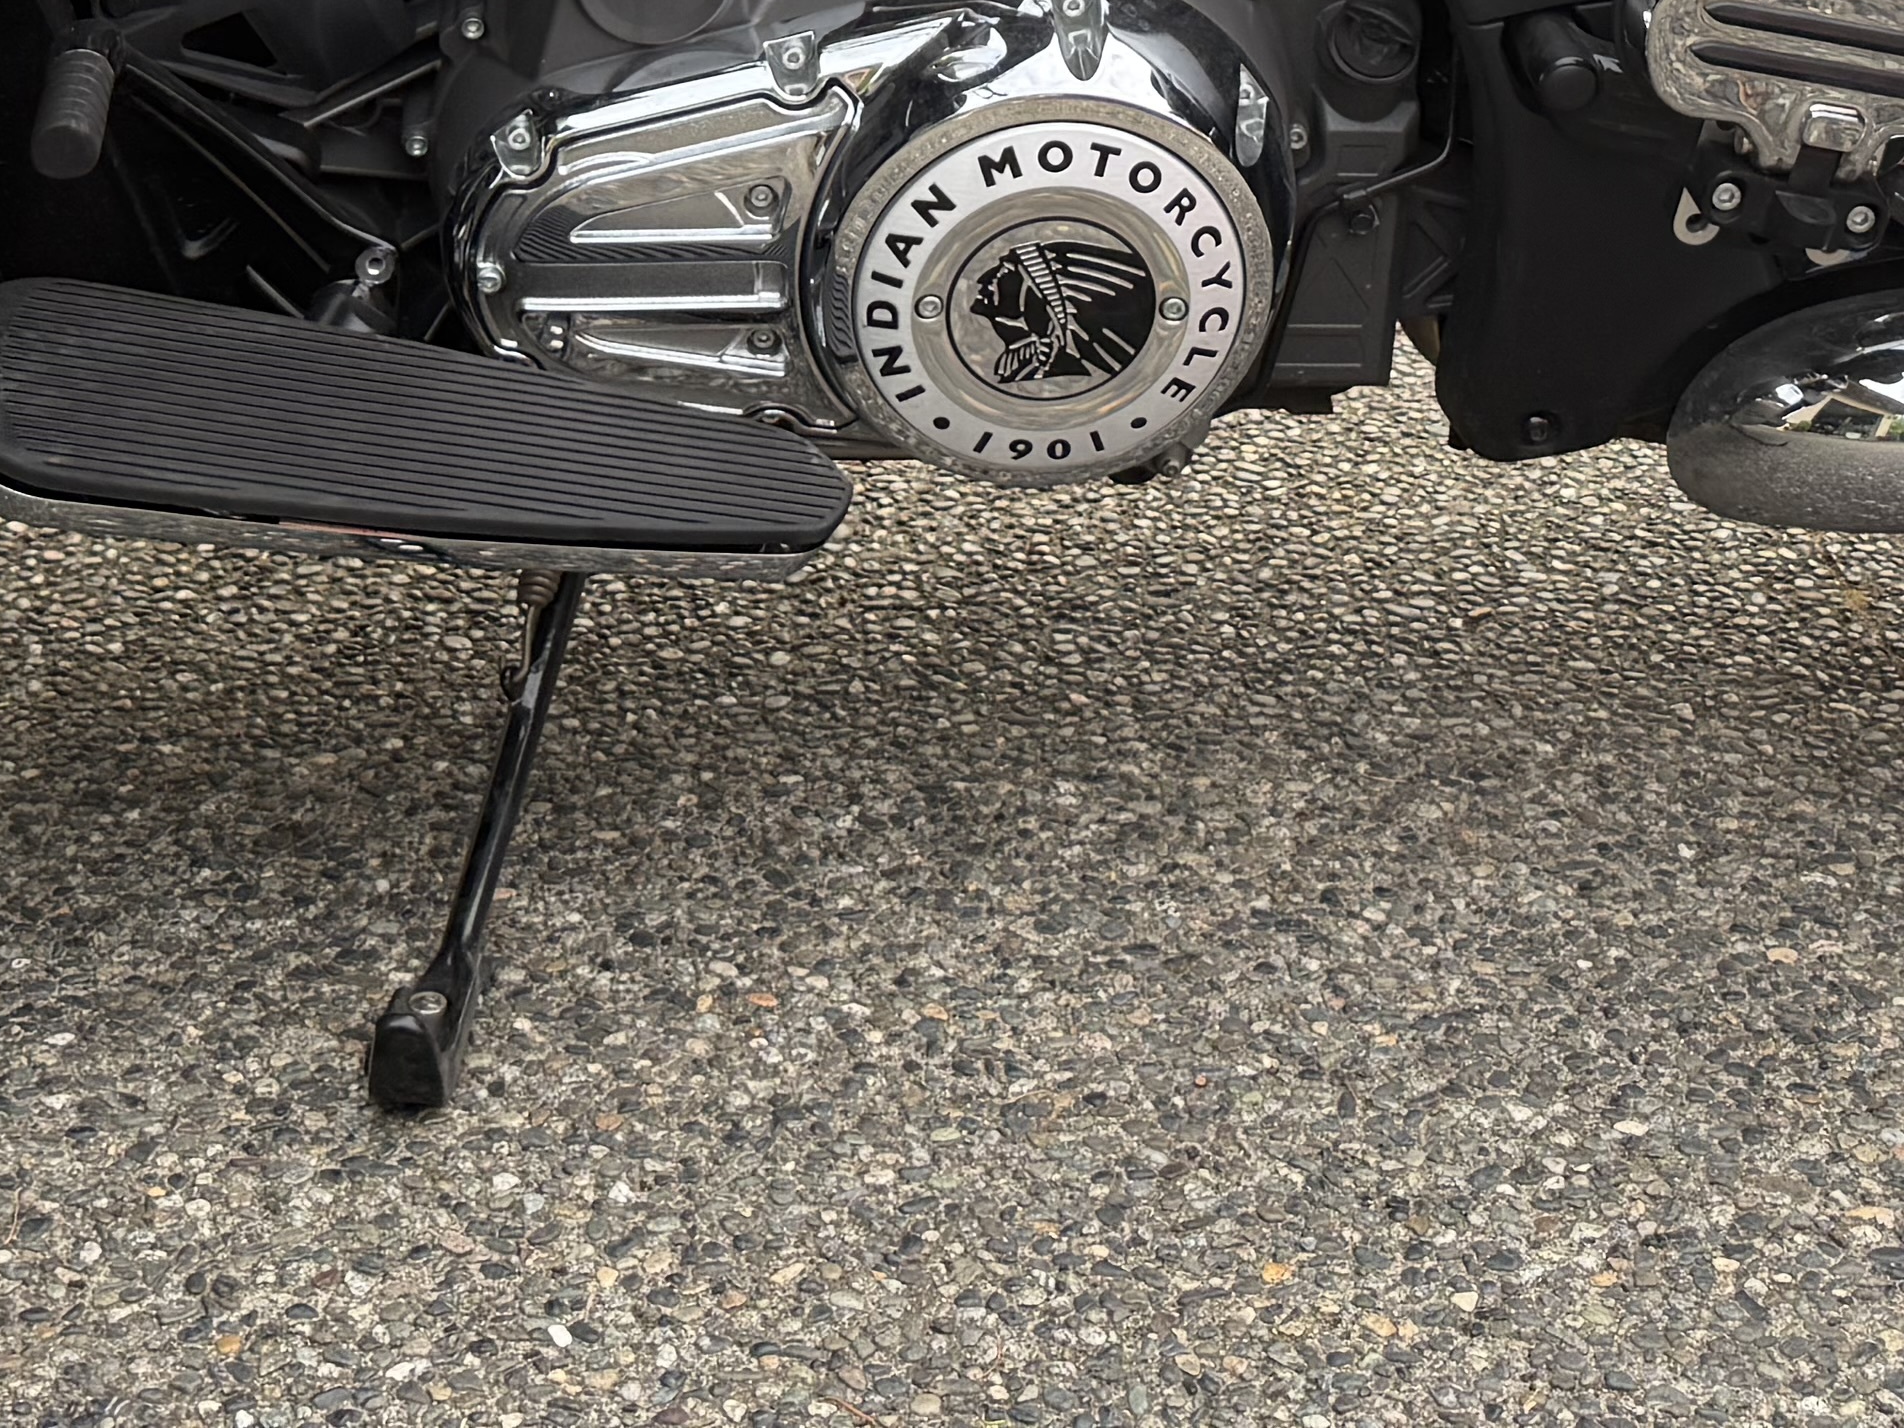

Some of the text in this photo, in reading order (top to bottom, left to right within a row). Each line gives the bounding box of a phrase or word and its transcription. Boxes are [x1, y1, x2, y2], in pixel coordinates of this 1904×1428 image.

[865, 139, 1234, 404] INDIAN MOTORCYCLE
[972, 430, 1106, 461] 1901
